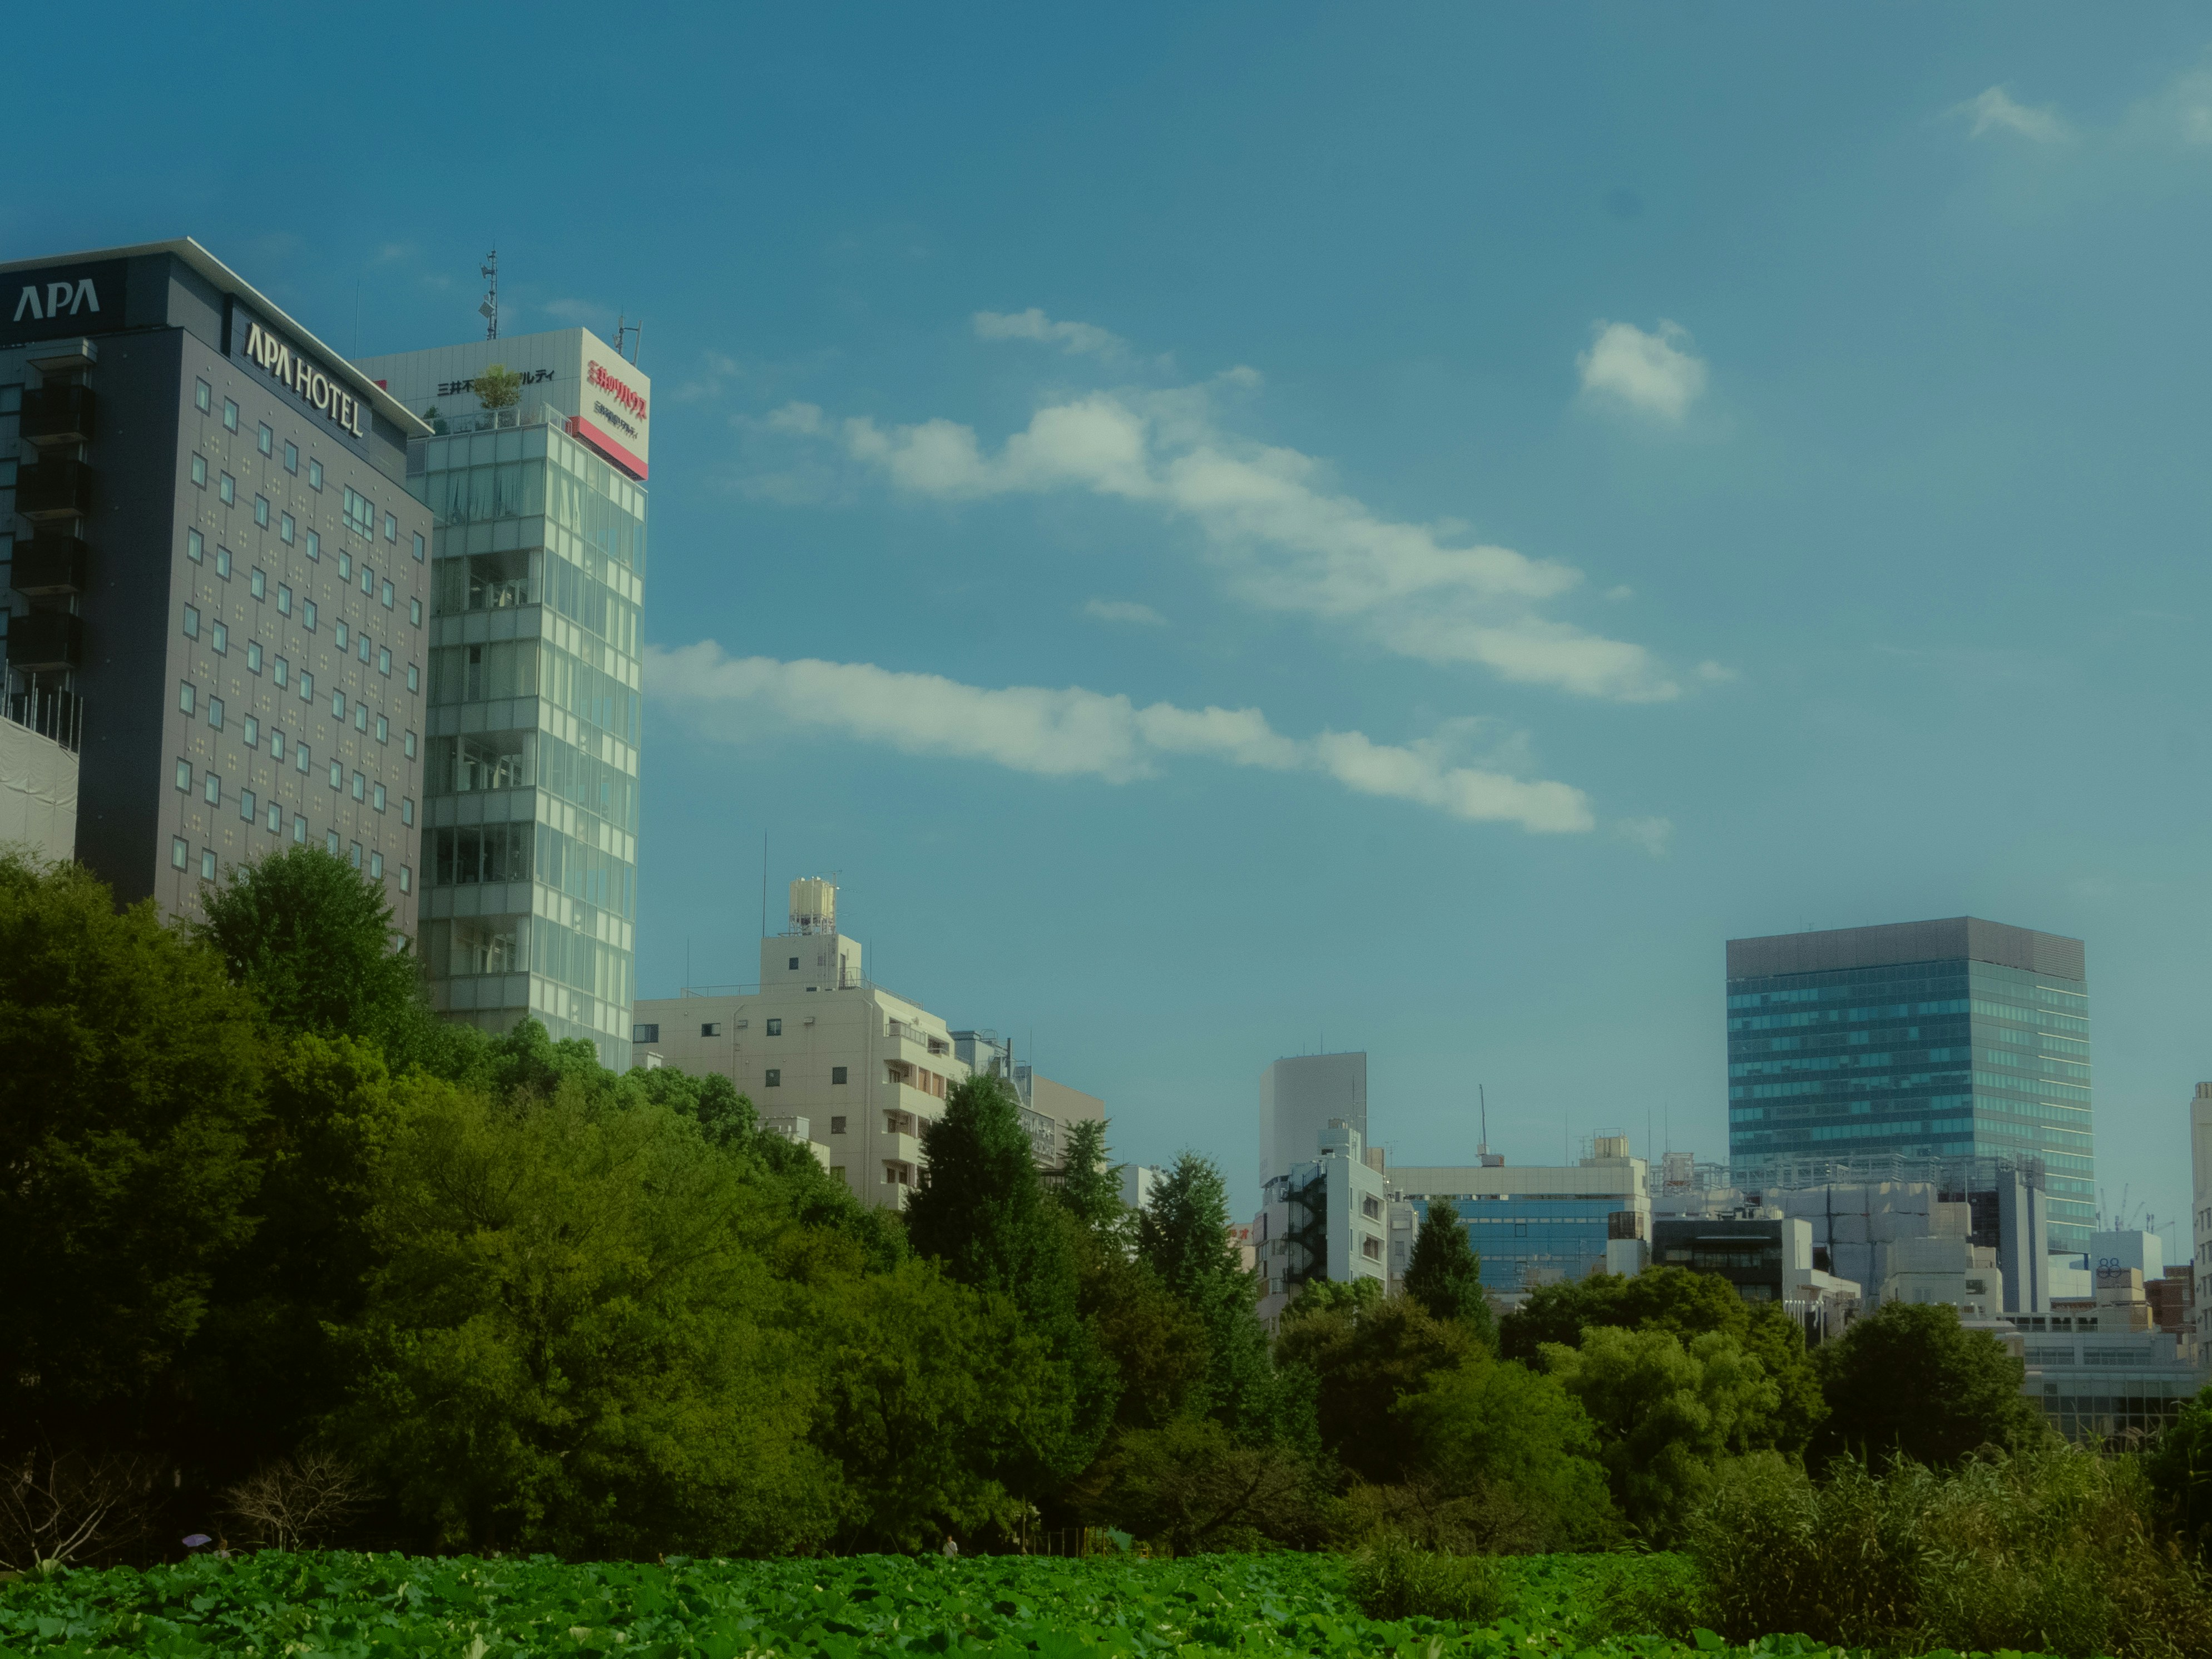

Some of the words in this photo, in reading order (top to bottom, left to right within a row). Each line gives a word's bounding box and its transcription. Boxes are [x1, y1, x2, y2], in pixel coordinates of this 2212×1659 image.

[13, 279, 100, 321] APA
[247, 323, 291, 385] APA
[296, 357, 363, 438] HOTEL
[437, 369, 555, 397] 三井不ルティ
